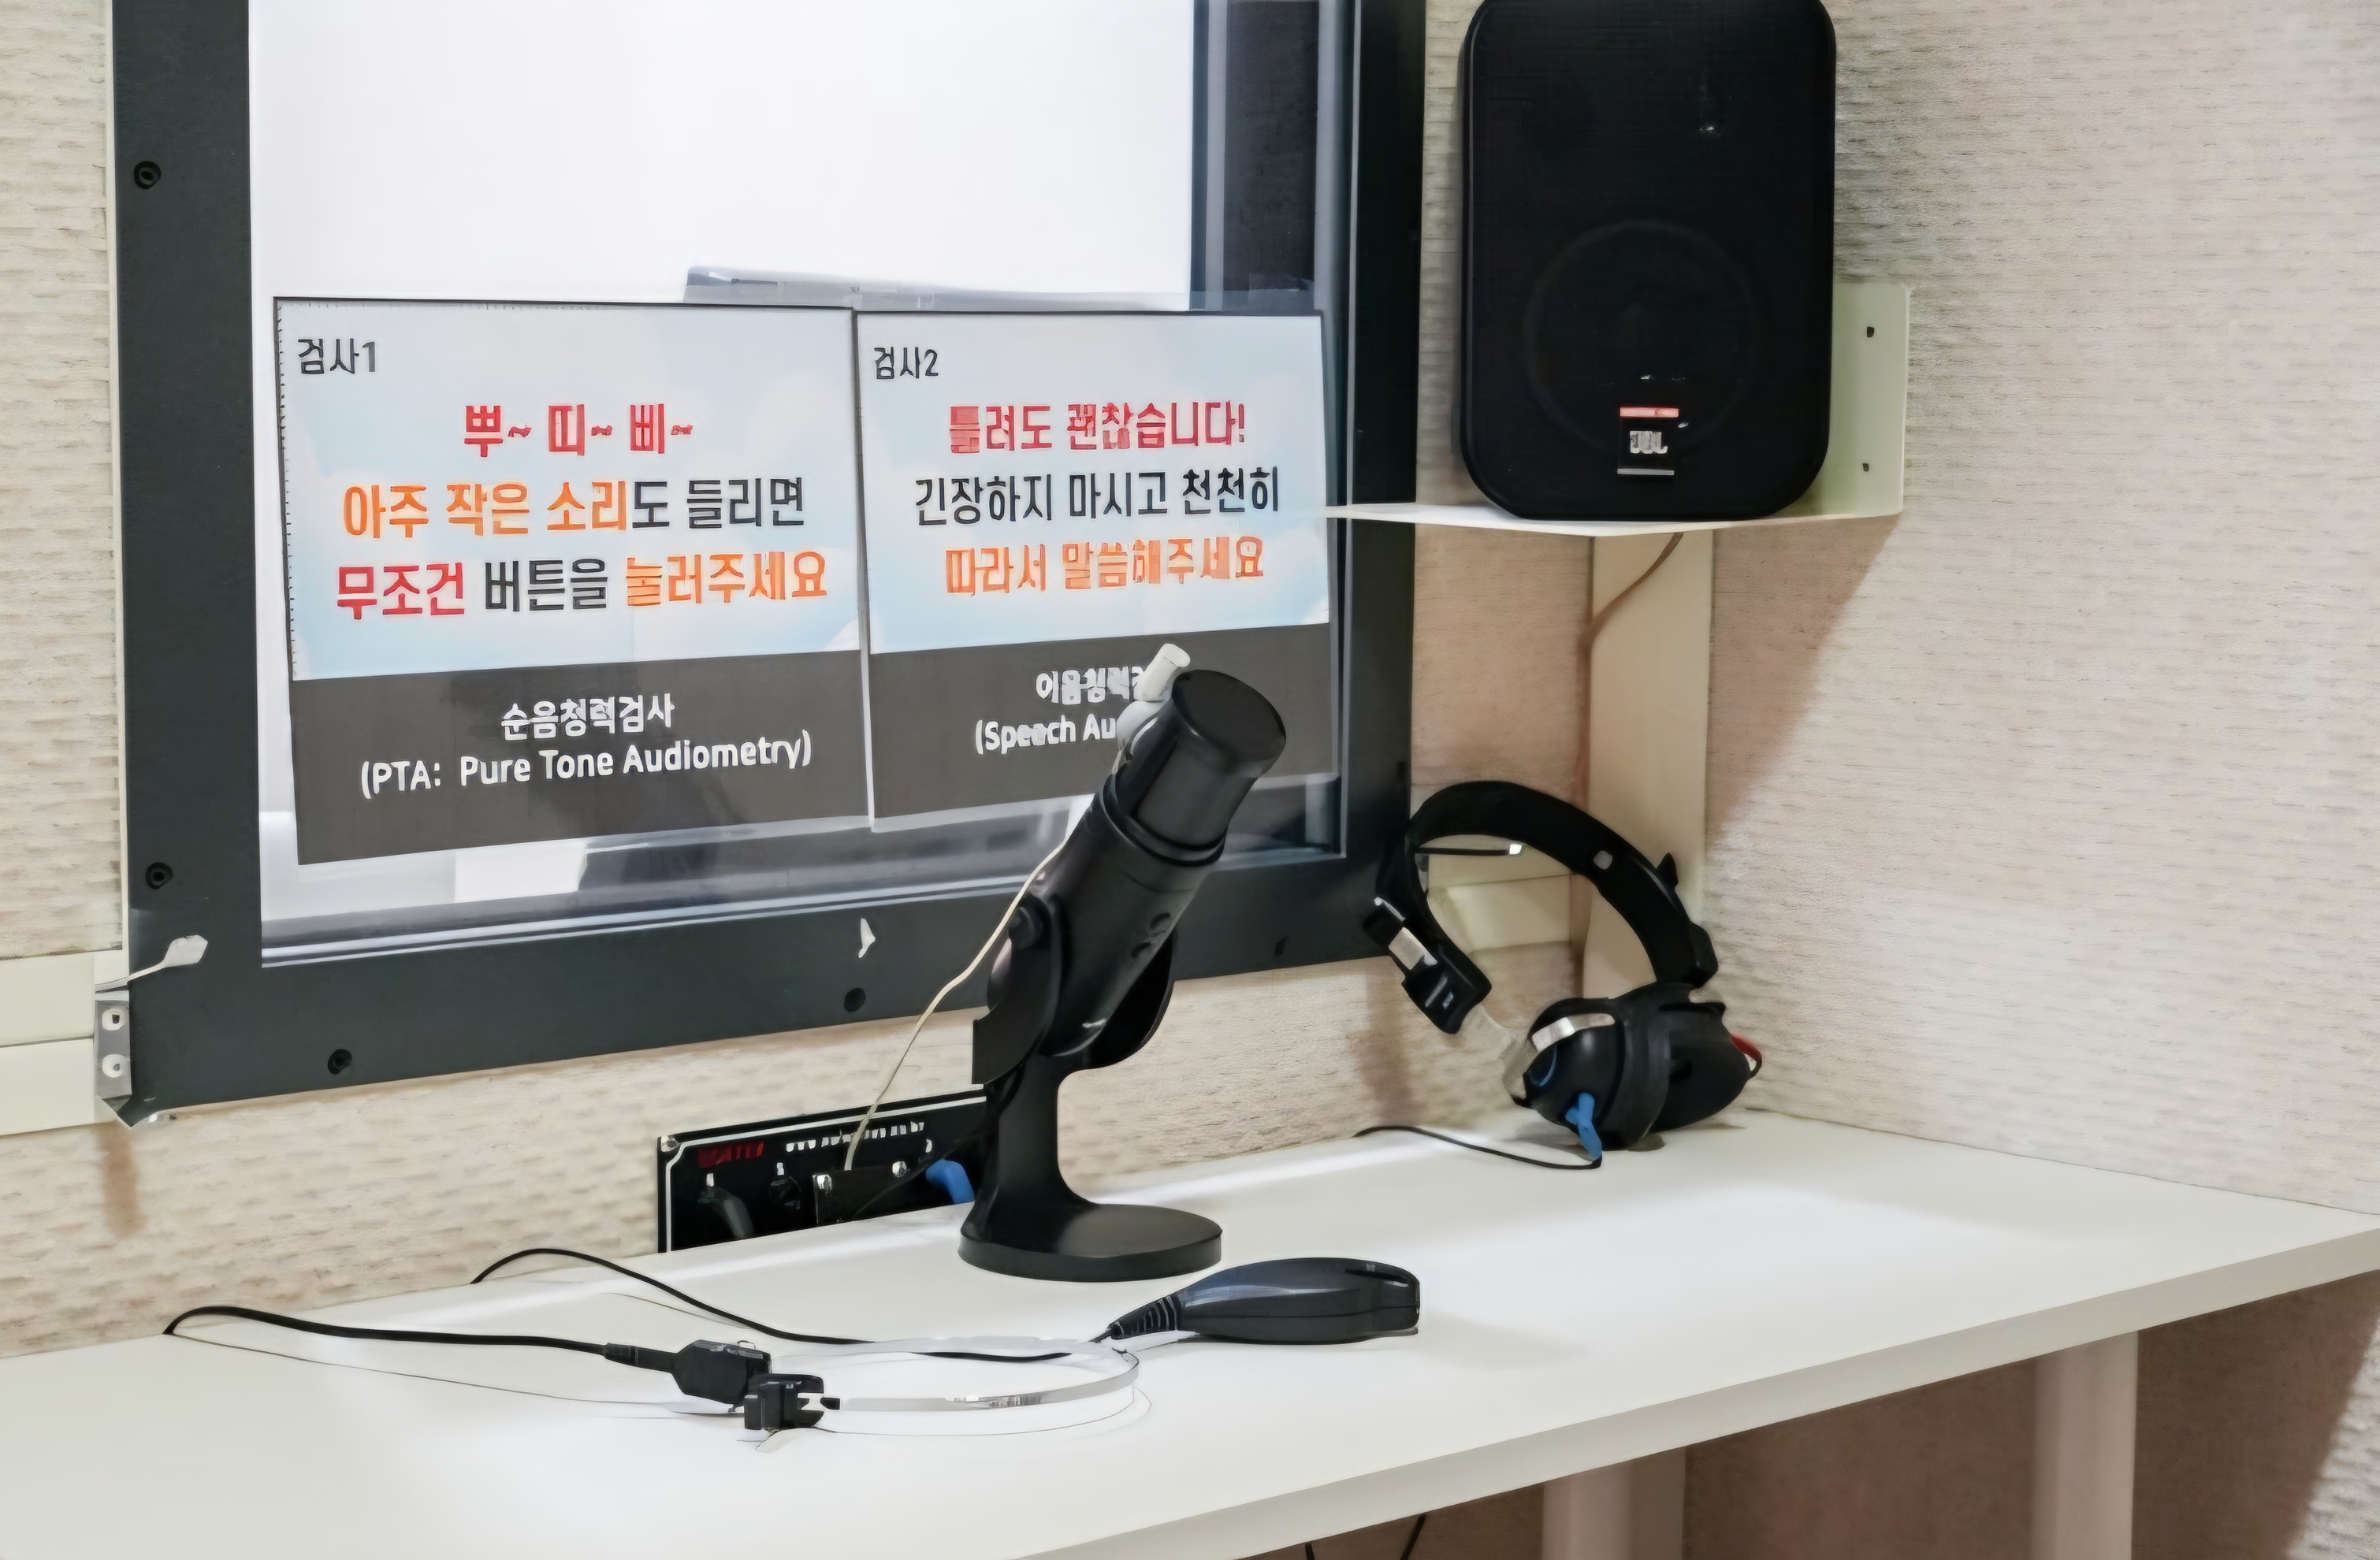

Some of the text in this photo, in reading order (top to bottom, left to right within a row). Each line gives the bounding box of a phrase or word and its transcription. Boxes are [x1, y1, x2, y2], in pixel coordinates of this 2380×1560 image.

[297, 337, 376, 375] 검사1
[873, 346, 939, 380] 검사2
[463, 403, 694, 457] 뿌~ 띠~ 삐~
[949, 400, 1245, 454] 틀려도 괜찮습니다!
[343, 477, 805, 539] 아주 작은 소리도 들리면
[915, 466, 1278, 526] 긴장하지 마시고 천천히
[337, 550, 827, 620] 무조건 버튼을 눌러주세요
[945, 536, 1264, 596] 따라서 말씀해주세요
[500, 693, 675, 741] 순음청력검사
[360, 728, 813, 800] (PTA: Pure Tone Audiometry)
